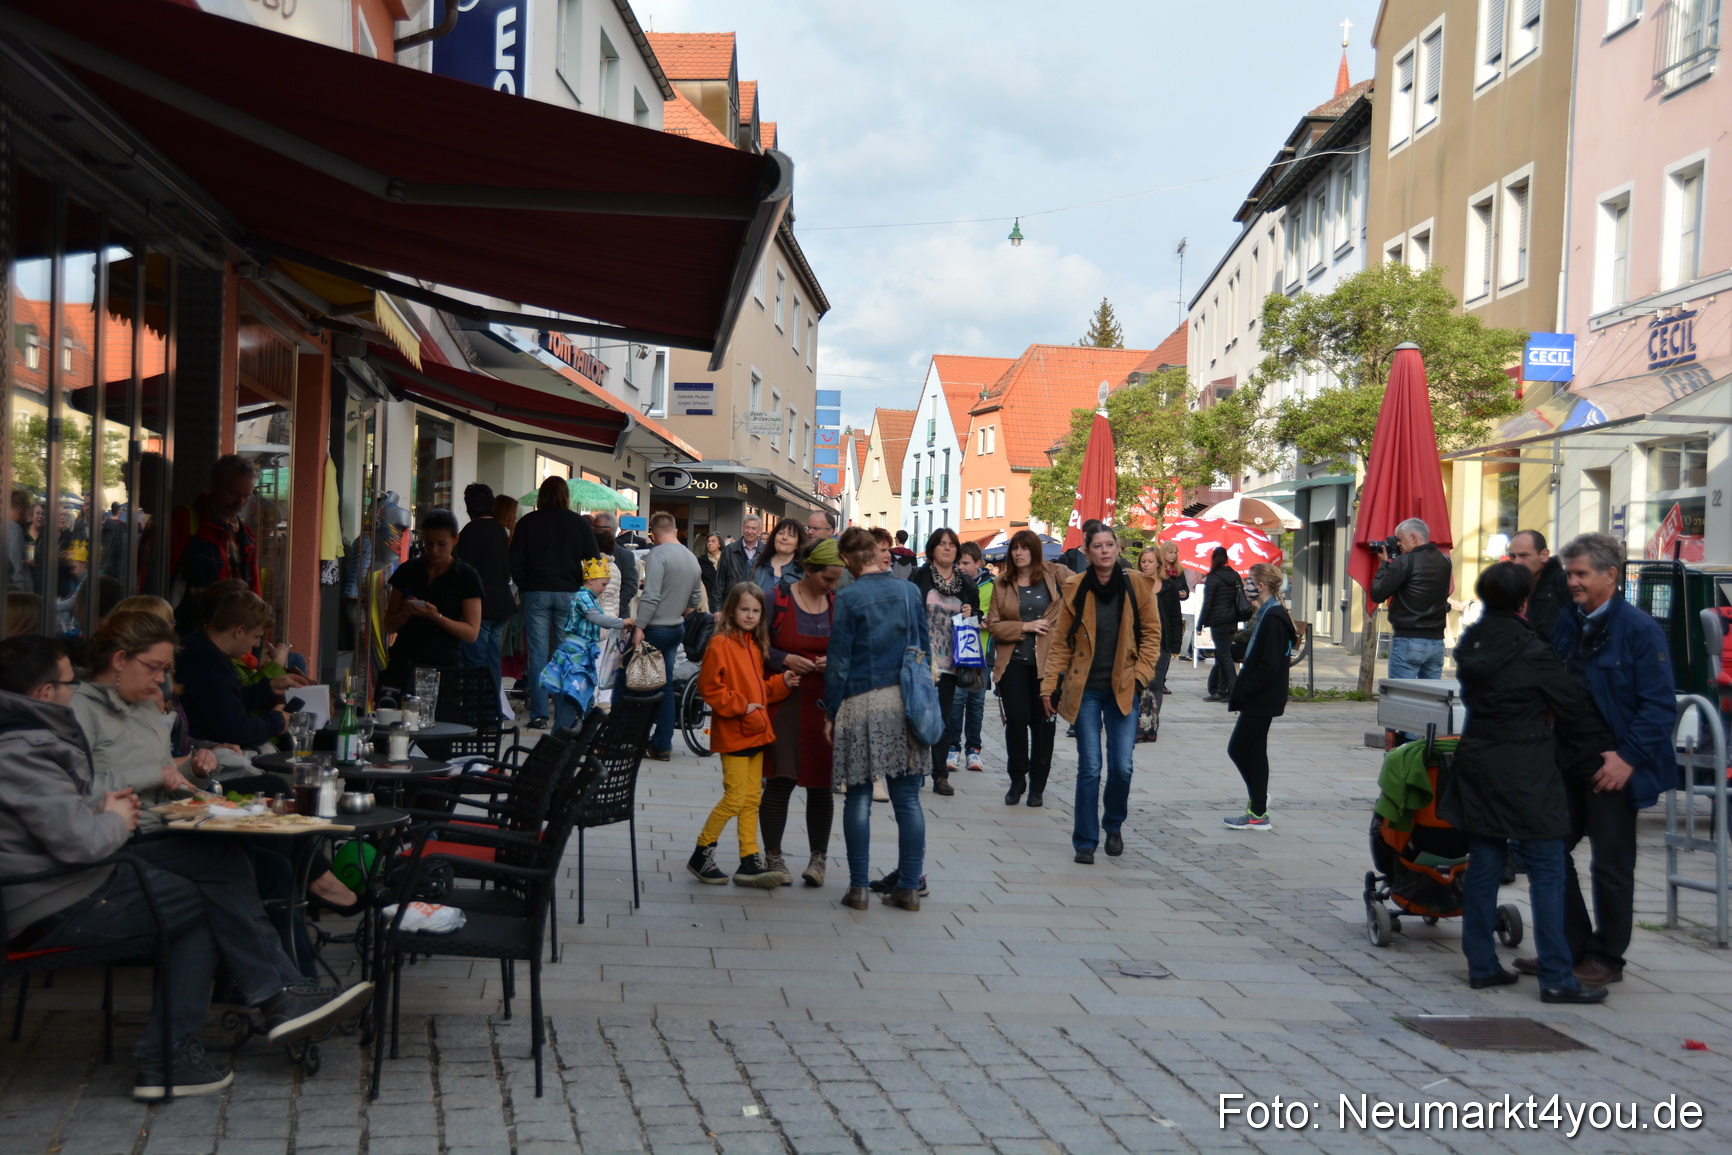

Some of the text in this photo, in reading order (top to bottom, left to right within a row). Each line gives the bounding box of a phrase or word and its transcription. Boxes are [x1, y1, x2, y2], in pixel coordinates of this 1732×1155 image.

[1647, 319, 1696, 362] CECIL
[548, 330, 606, 384] TOM TAILOR
[1529, 350, 1570, 363] CECIL
[1712, 489, 1722, 507] 22
[1181, 559, 1199, 569] Julius
